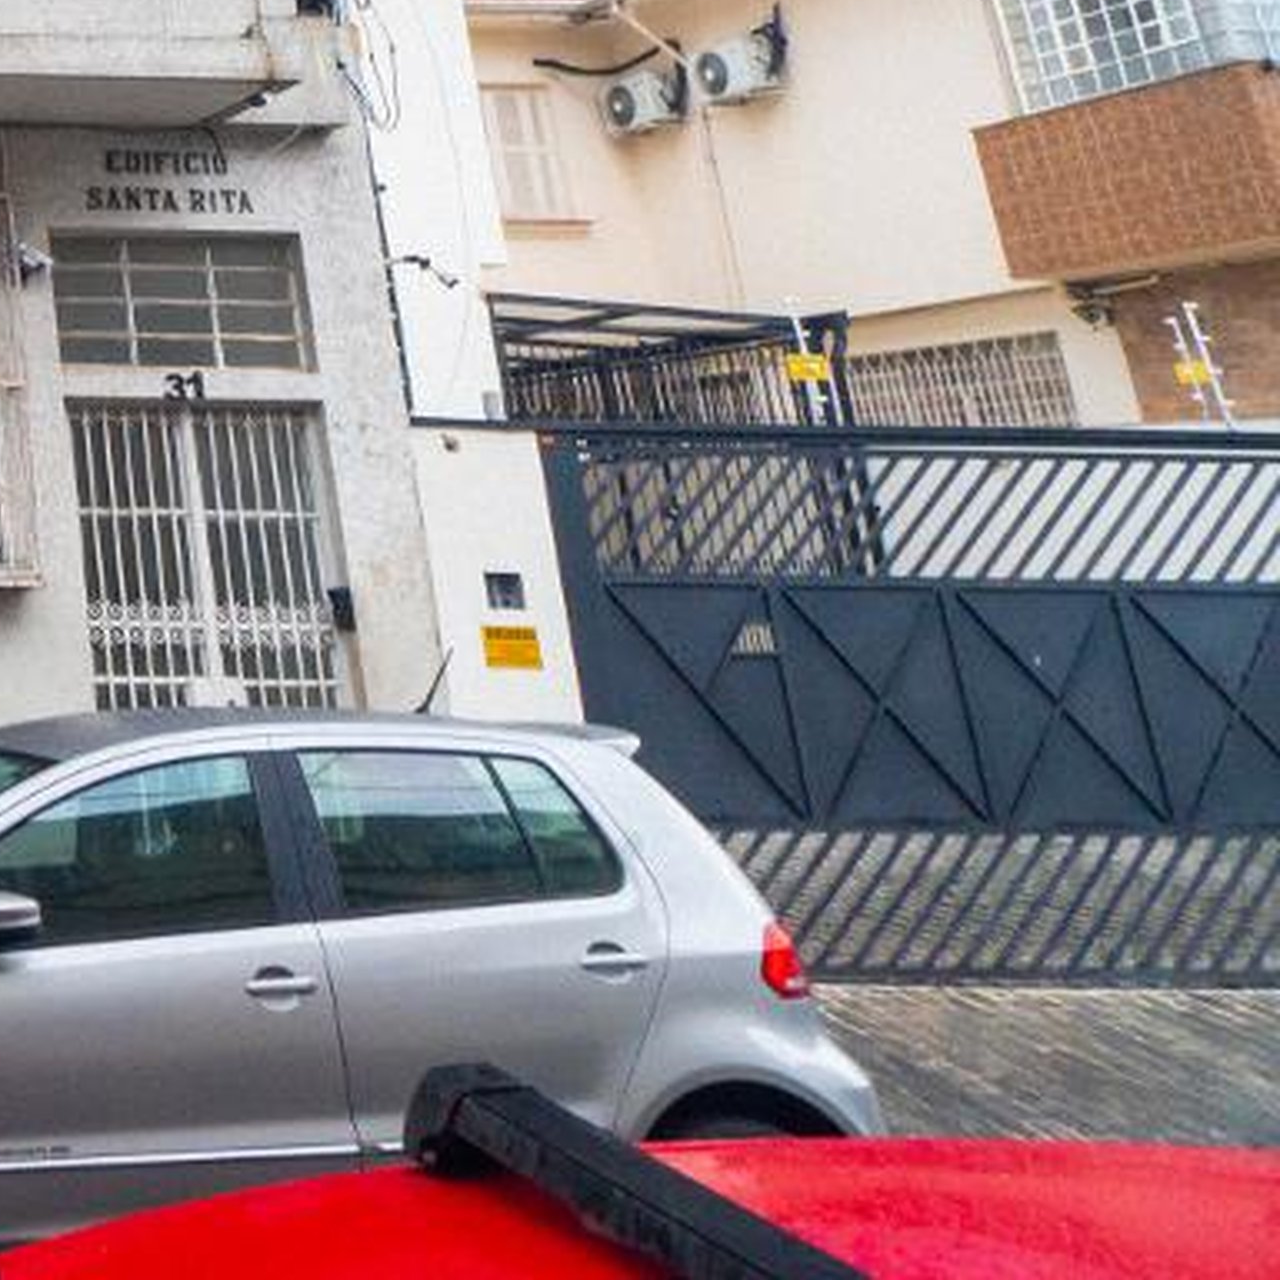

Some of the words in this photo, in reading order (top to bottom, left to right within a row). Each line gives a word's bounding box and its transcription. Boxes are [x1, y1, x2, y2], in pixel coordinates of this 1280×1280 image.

[105, 148, 228, 175] EDIFICIO
[85, 185, 180, 213] SANTA
[189, 187, 255, 215] RITA
[164, 370, 204, 402] 31
